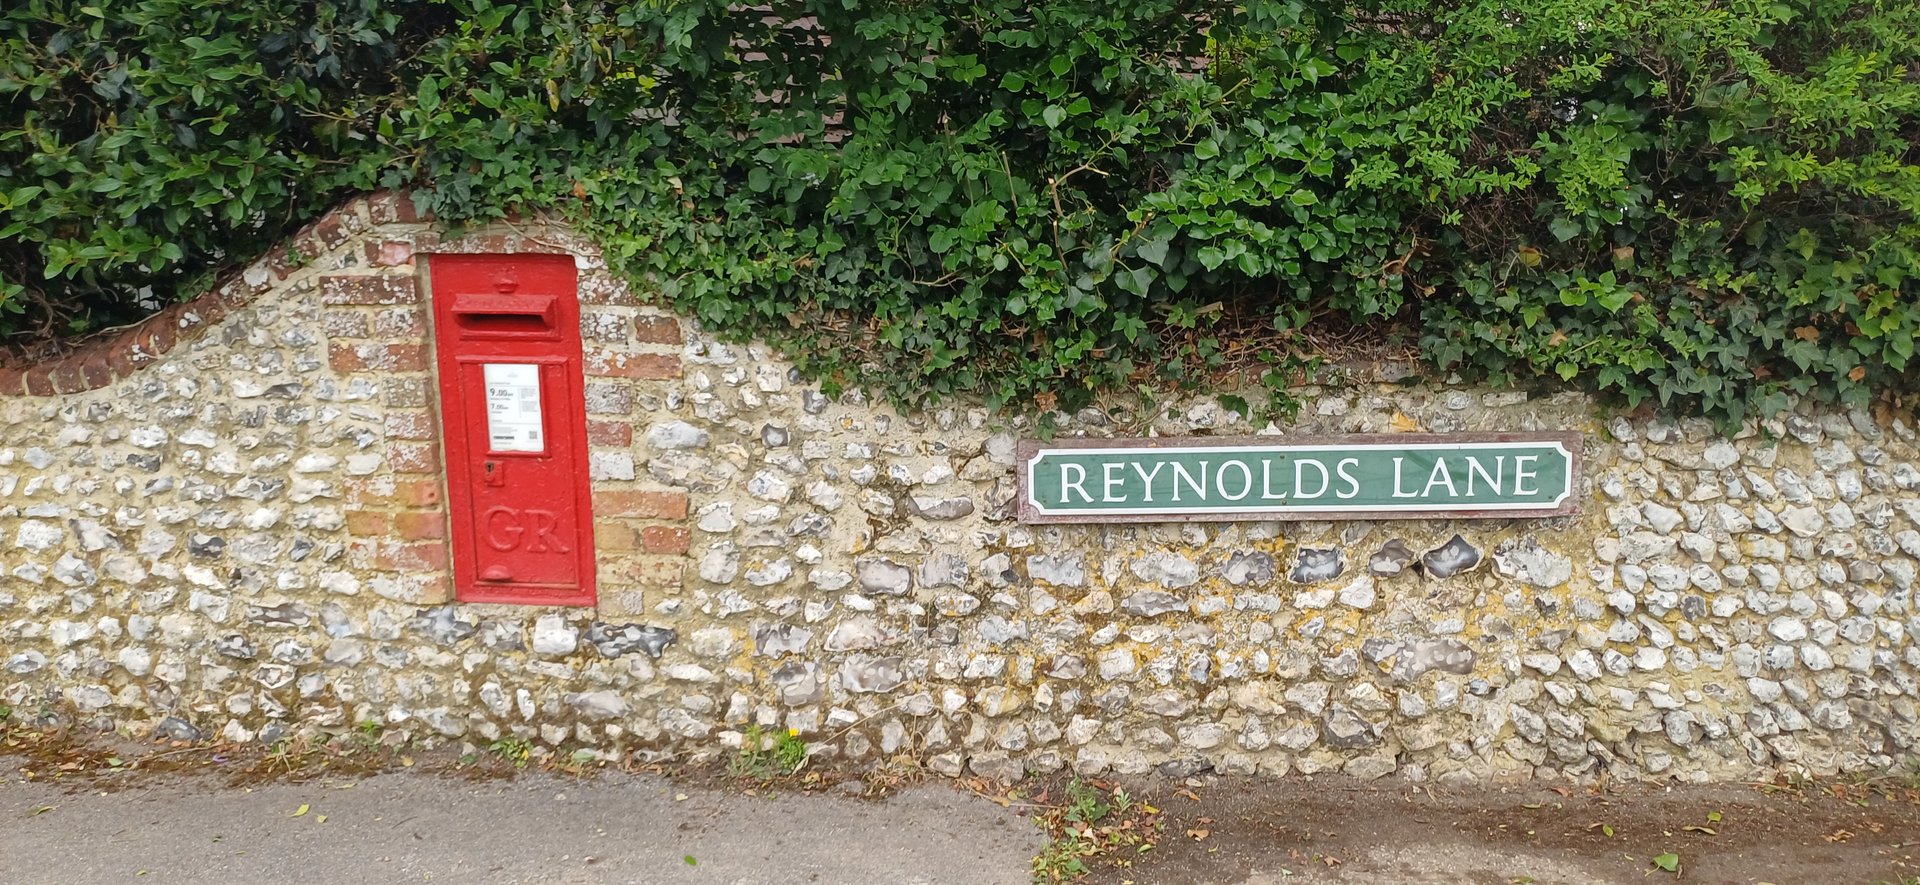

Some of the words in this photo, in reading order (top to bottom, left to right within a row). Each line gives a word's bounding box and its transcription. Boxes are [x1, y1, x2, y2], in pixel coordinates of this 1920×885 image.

[1059, 457, 1360, 504] REYNOLDS
[1391, 454, 1540, 499] LANE
[483, 505, 570, 554] GR
